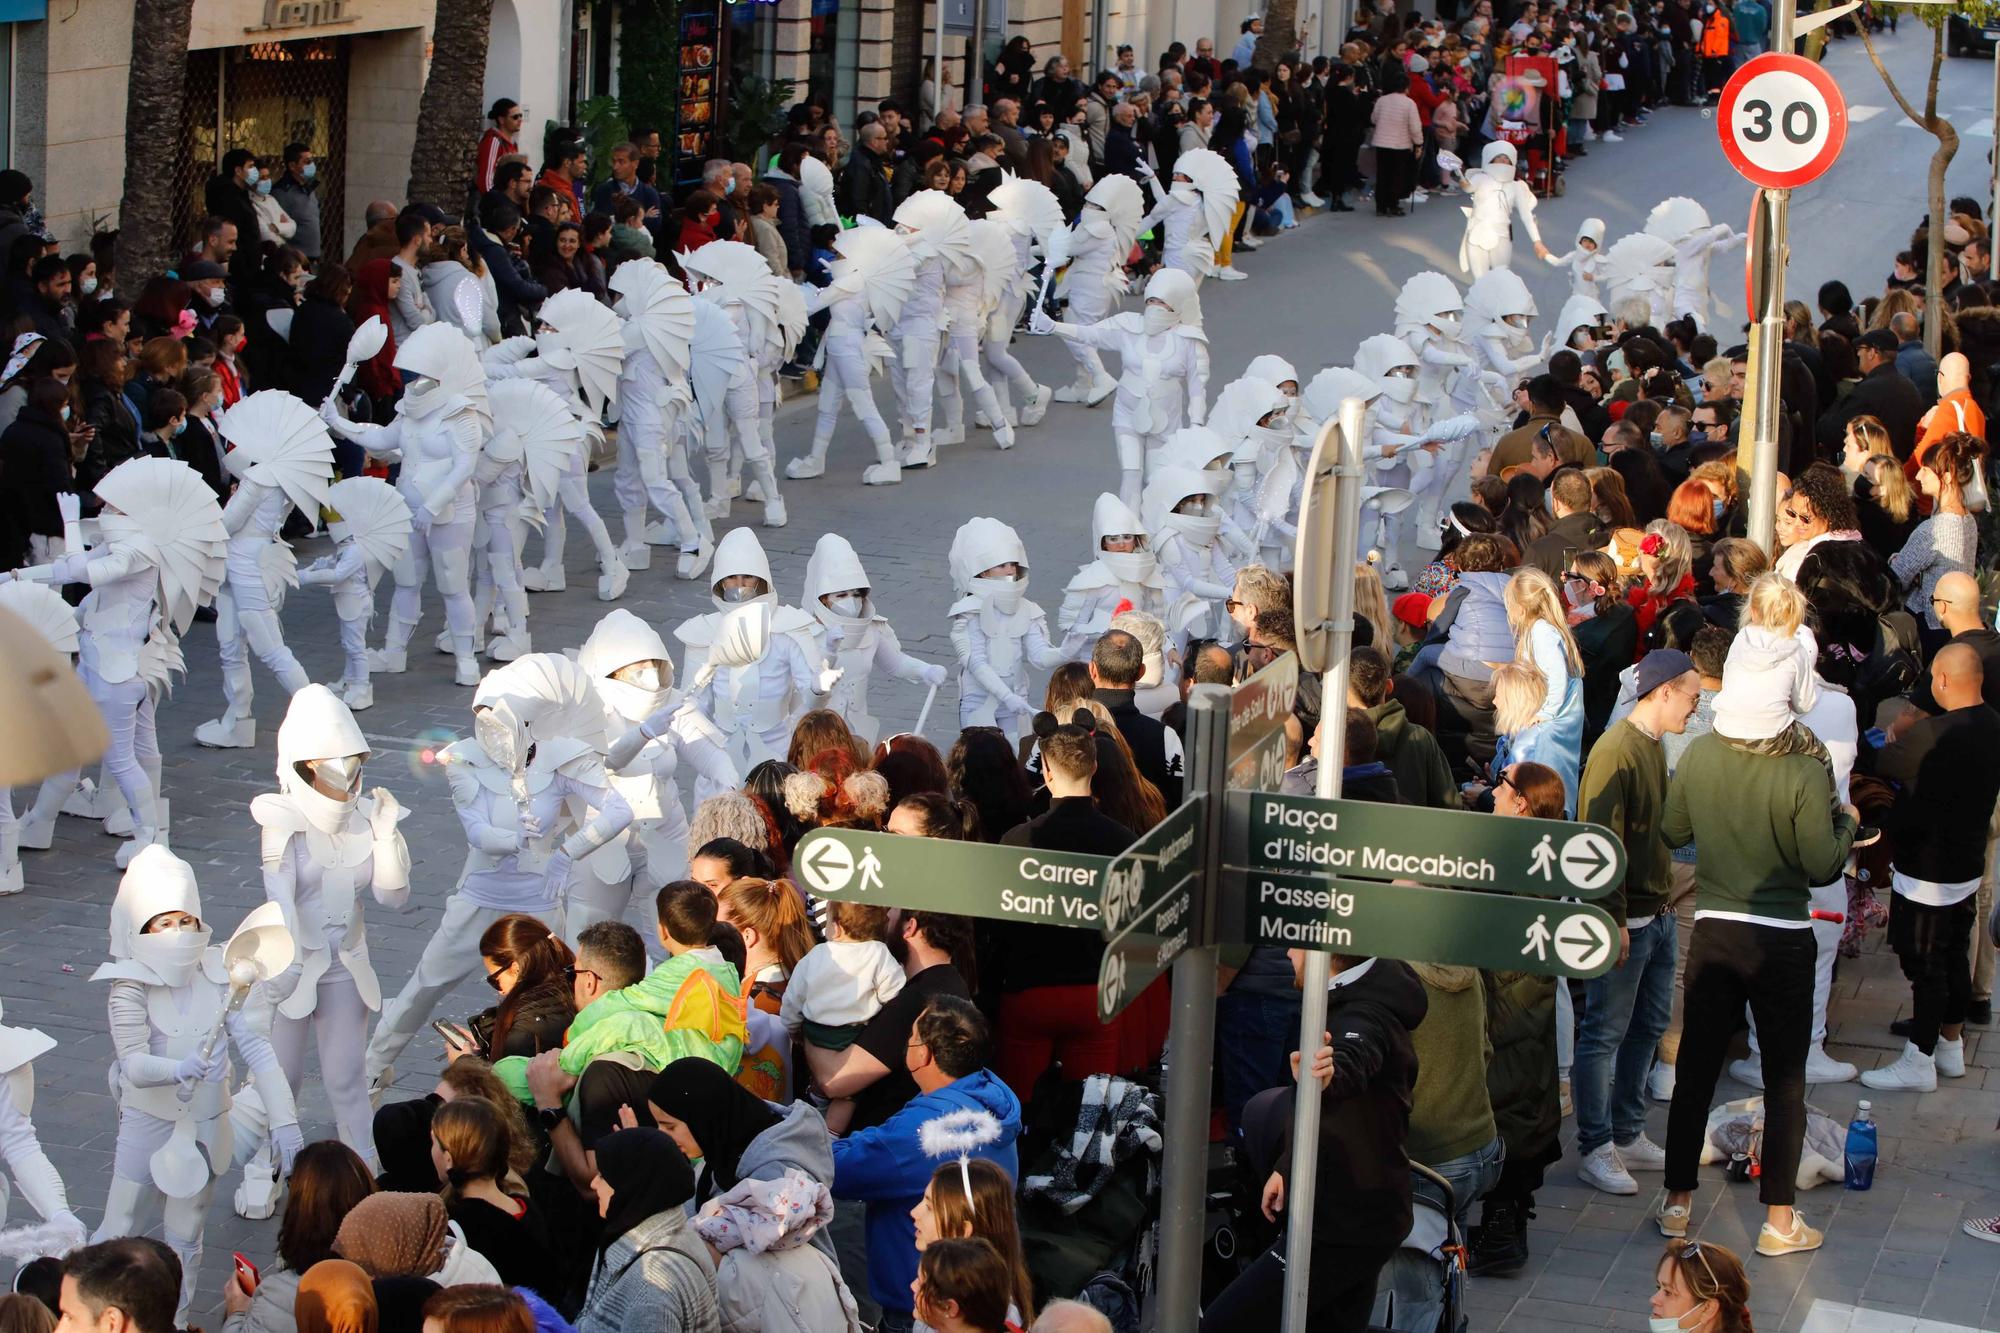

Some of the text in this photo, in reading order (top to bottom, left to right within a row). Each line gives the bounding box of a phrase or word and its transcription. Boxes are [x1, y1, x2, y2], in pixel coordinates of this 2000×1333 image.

[1742, 99, 1818, 145] 30
[1264, 801, 1338, 834] Plaça
[1157, 823, 1194, 872] Ajuntament
[1263, 837, 1496, 881] d'Isidor Macabich
[1019, 857, 1098, 886] Carrer
[1000, 889, 1102, 921] Sant Vic
[1155, 891, 1190, 936] Passeig de
[1260, 880, 1354, 917] Passeig
[1260, 915, 1352, 946] Marítim
